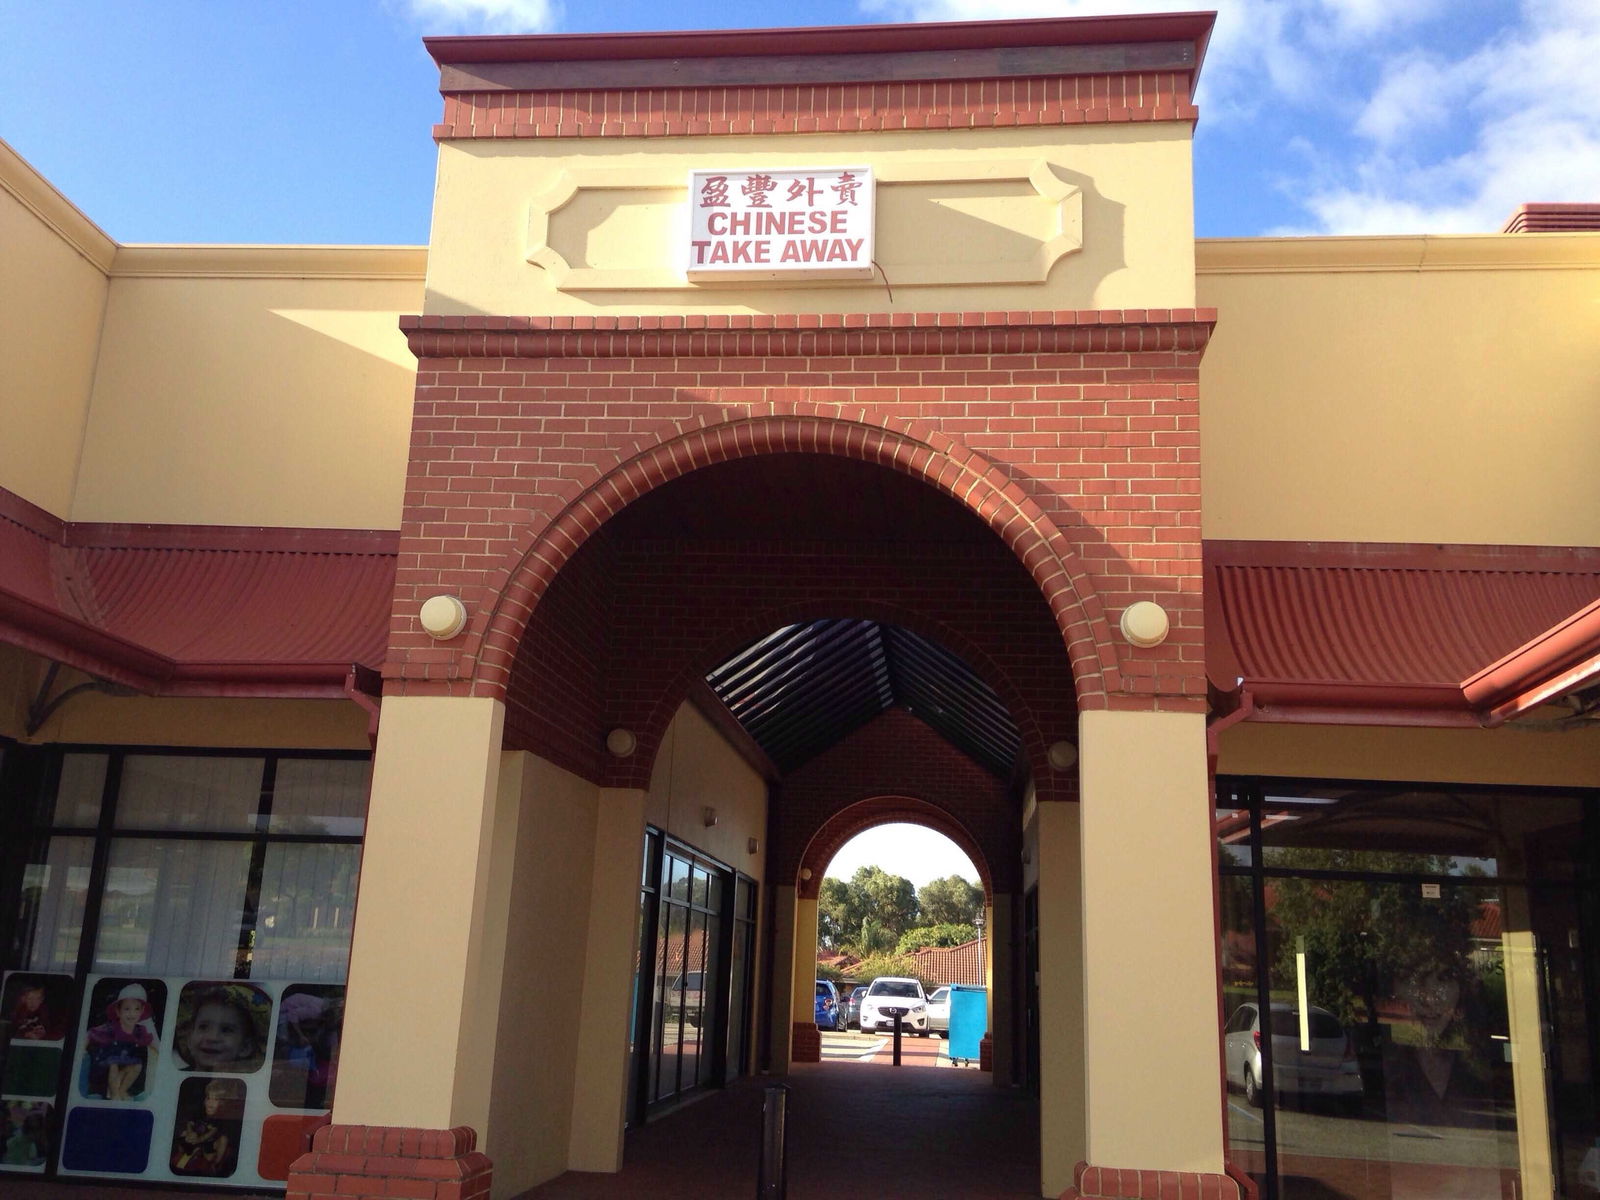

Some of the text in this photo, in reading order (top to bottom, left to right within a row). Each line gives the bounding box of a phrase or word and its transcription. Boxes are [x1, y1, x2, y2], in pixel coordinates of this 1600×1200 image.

[700, 172, 862, 208] 盈豐外賣
[708, 210, 848, 235] CHINESE
[692, 238, 864, 264] TAKE AWAY
